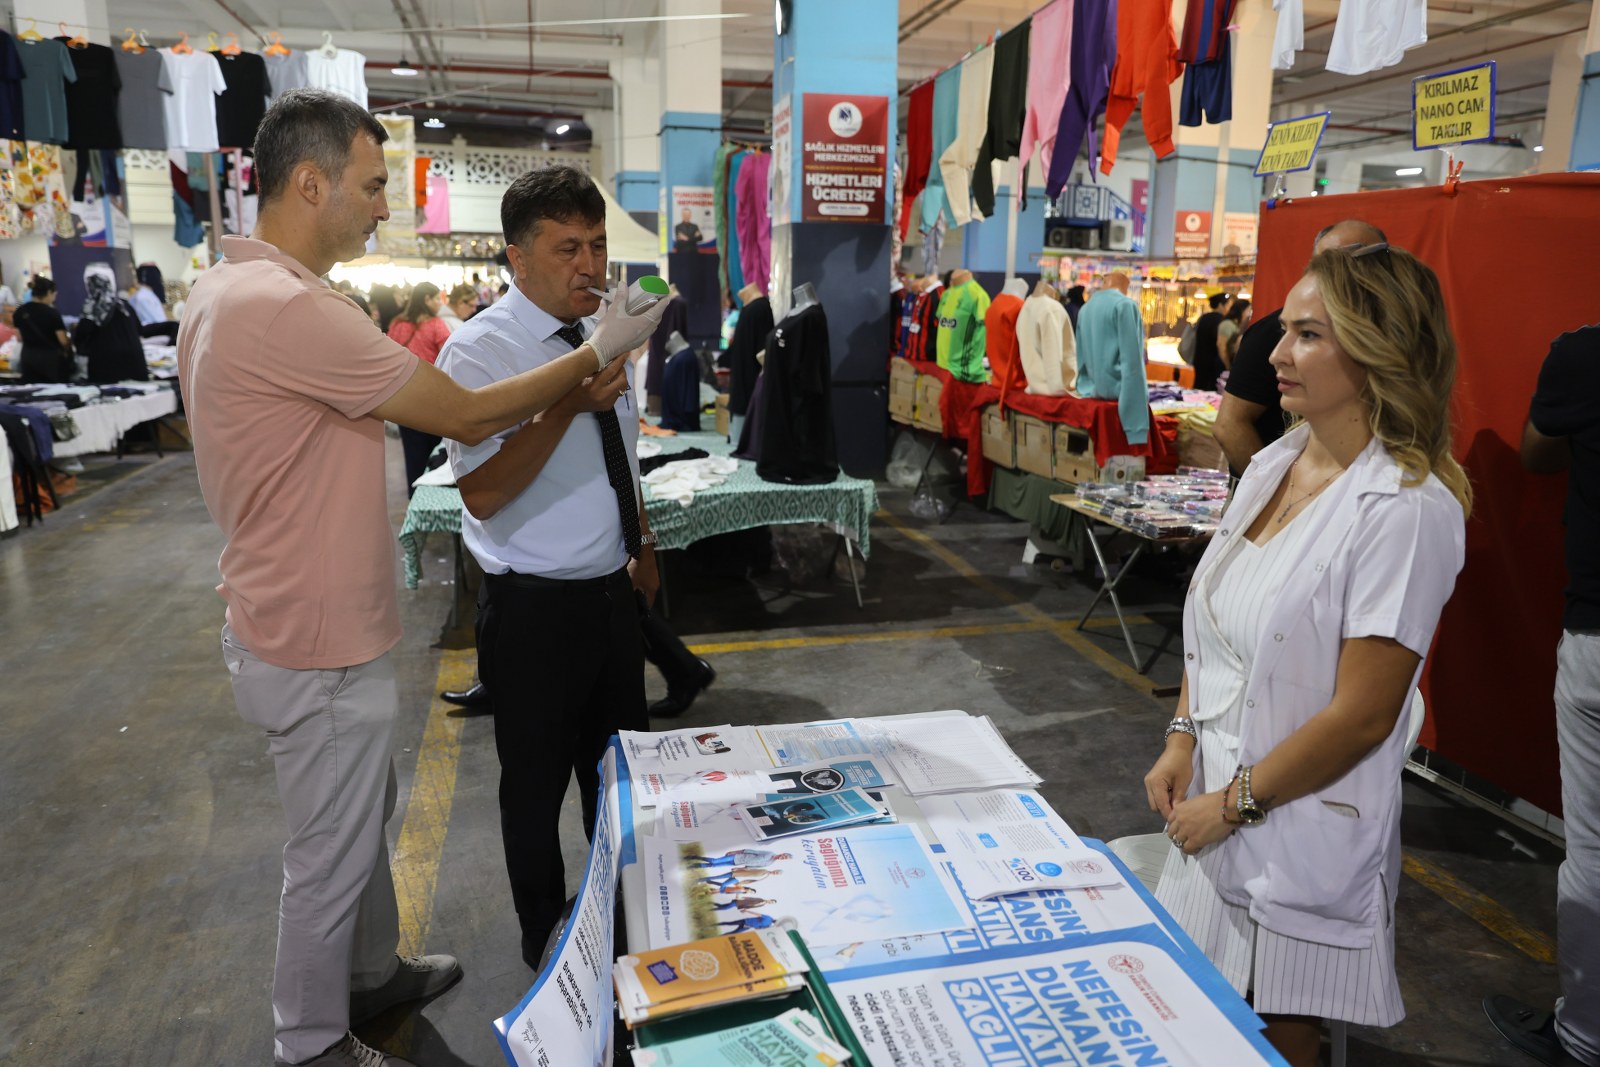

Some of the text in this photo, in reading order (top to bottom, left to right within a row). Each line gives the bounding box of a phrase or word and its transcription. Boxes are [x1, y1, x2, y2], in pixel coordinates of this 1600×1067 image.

[1425, 76, 1478, 98] KIRILMAZ
[1420, 102, 1454, 120] NANO
[805, 142, 835, 152] SAĞLIK
[1430, 122, 1472, 140] TAKILIR
[806, 173, 882, 188] HİZMETLERİ
[812, 186, 875, 202] ÜCRETSİZ
[818, 838, 848, 888] Sağlığımızı
[969, 896, 1020, 946] ATIN
[1003, 891, 1054, 940] ANS
[741, 940, 764, 972] MADDE
[864, 992, 884, 1015] ciddi
[898, 987, 912, 1006] kalp
[1062, 960, 1172, 1067] NEFESİN
[846, 994, 874, 1046] neden olur.
[880, 990, 904, 1028] solunum
[895, 1030, 916, 1050] yolu
[914, 984, 932, 1010] Tütün
[928, 1010, 938, 1022] ve
[934, 1024, 953, 1049] tütün
[1026, 966, 1126, 1067] DUMAN
[766, 1022, 808, 1060] SİGARAYA
